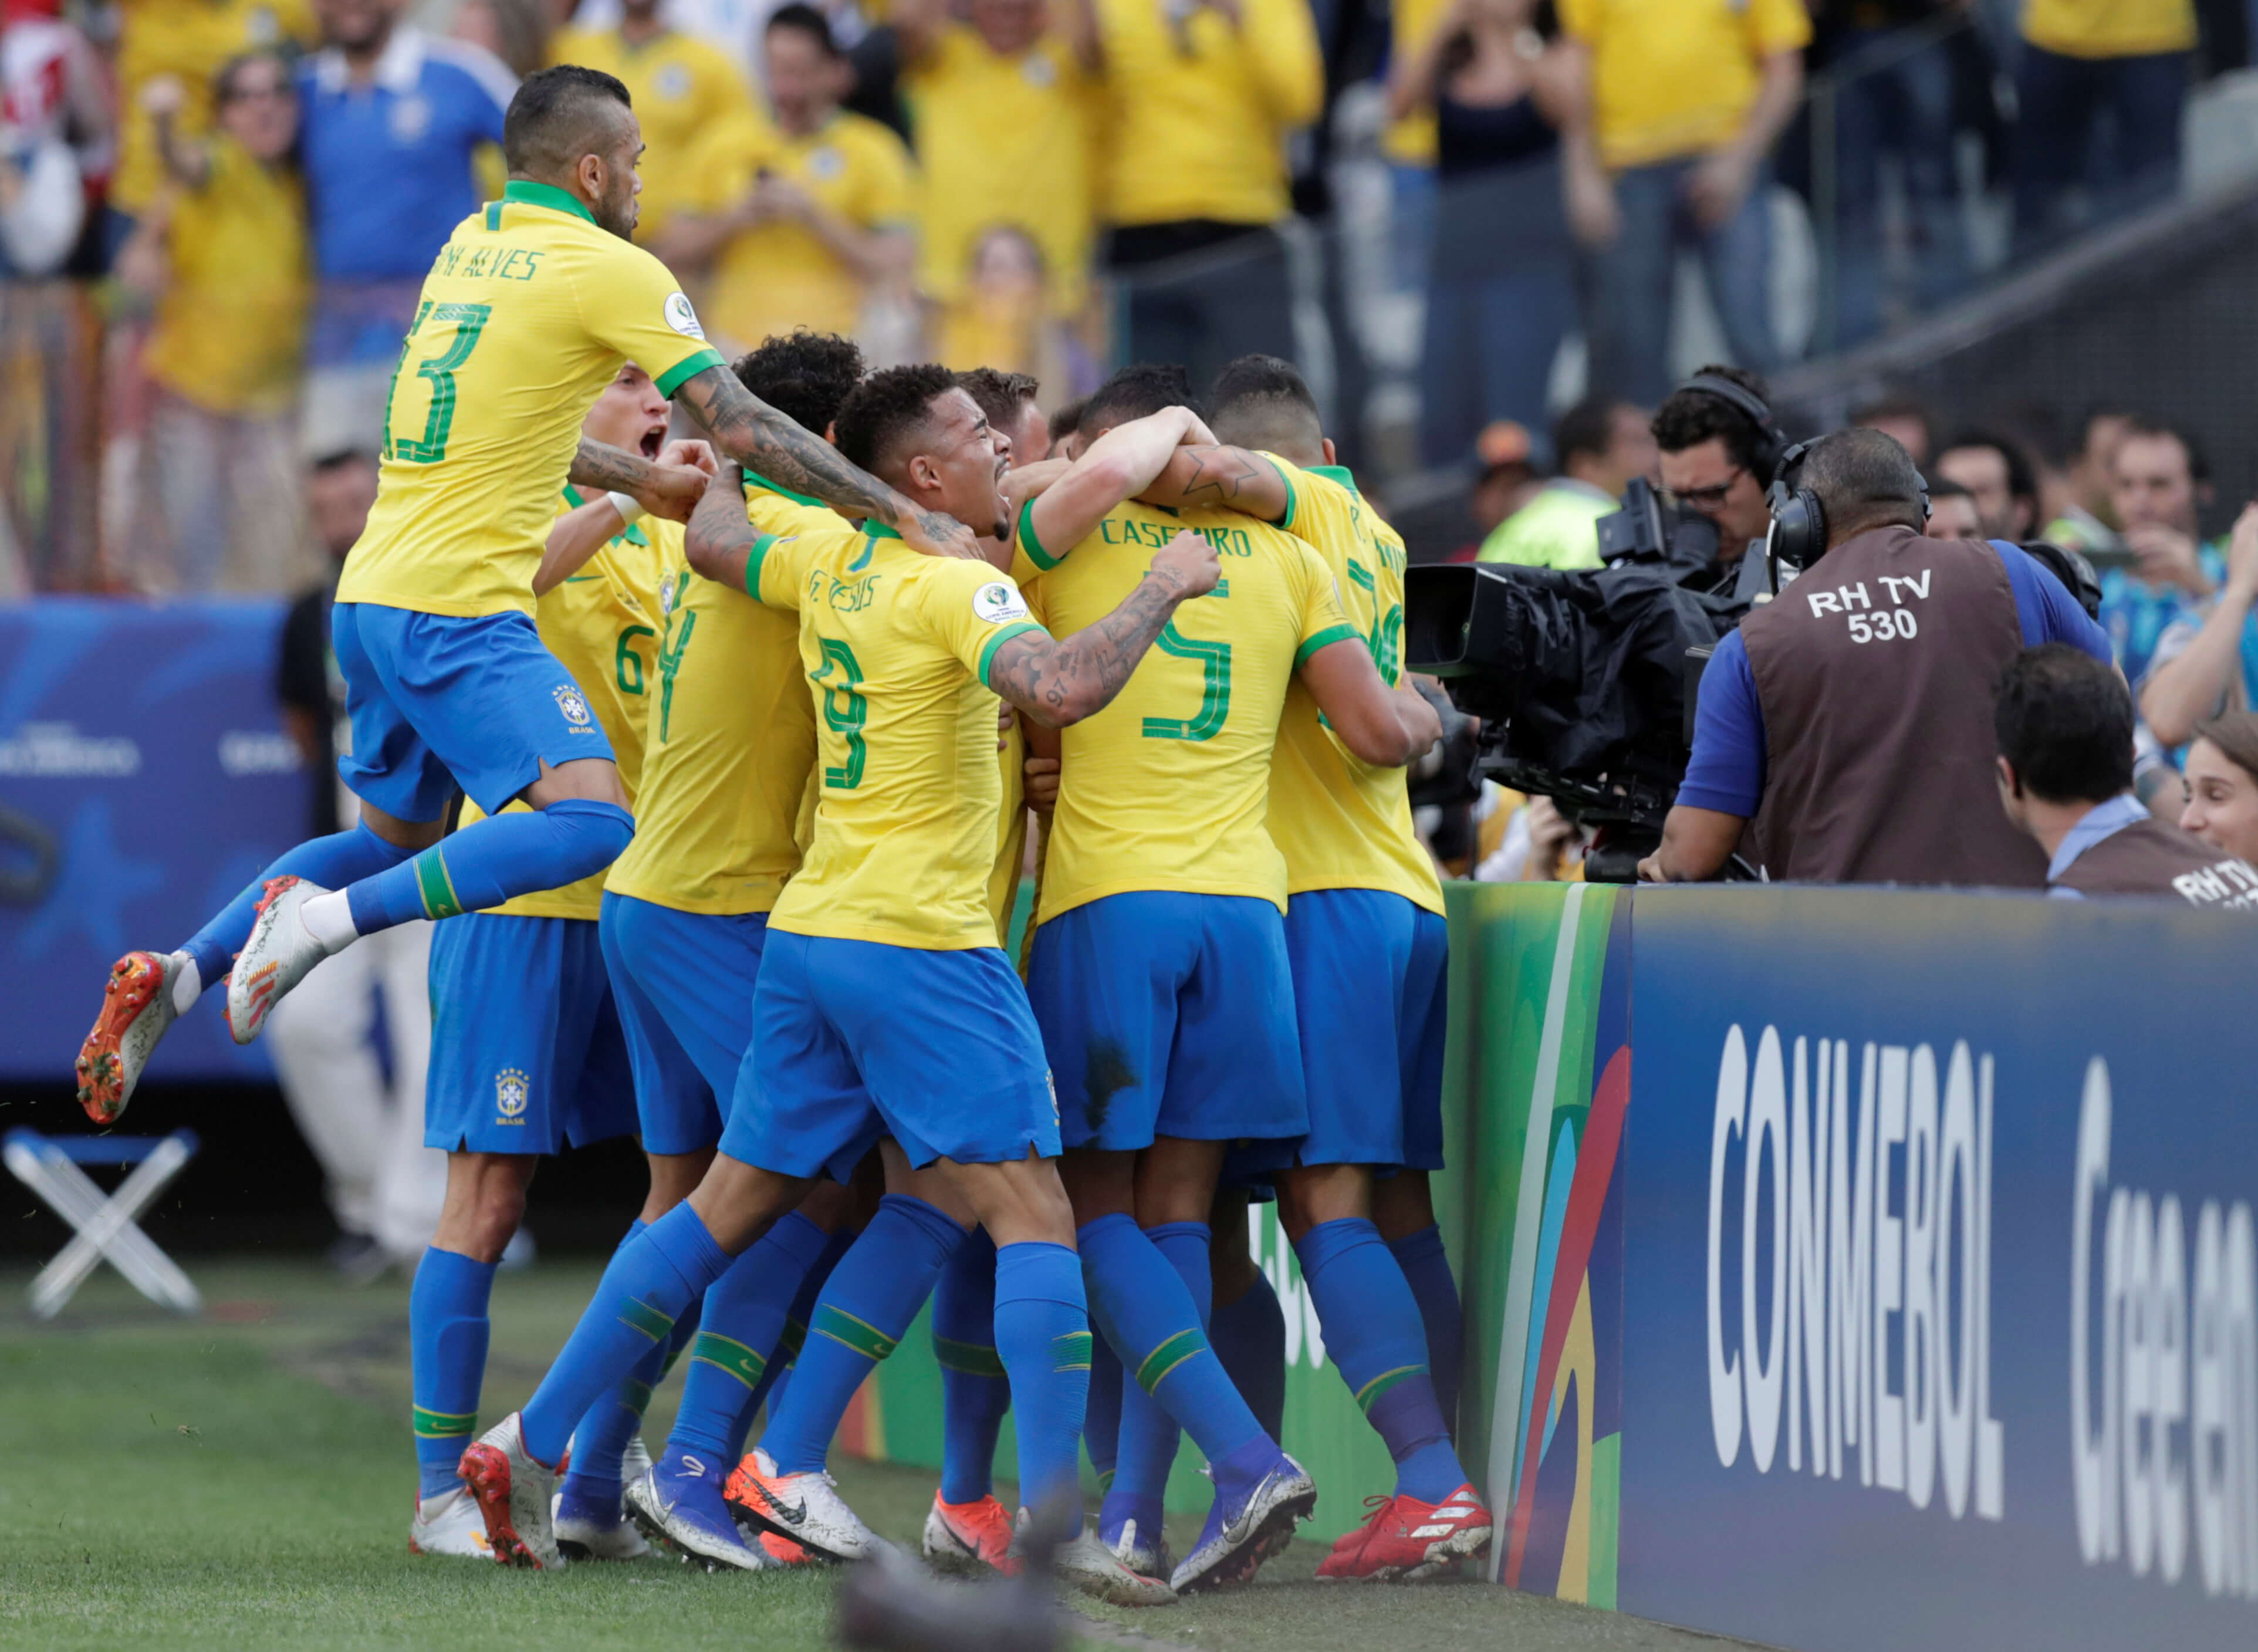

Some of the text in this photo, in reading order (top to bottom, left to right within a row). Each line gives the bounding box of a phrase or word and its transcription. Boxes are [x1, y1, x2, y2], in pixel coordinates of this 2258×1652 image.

[461, 248, 546, 281] ALVES
[382, 301, 493, 464] 13
[1807, 568, 1932, 618] RH TV
[1848, 608, 1918, 644] 530
[616, 624, 655, 695] 6
[1141, 570, 1231, 742] 5
[810, 635, 867, 789] 9
[2172, 866, 2232, 908] RH
[1707, 1023, 2004, 1521] CONMEBOL
